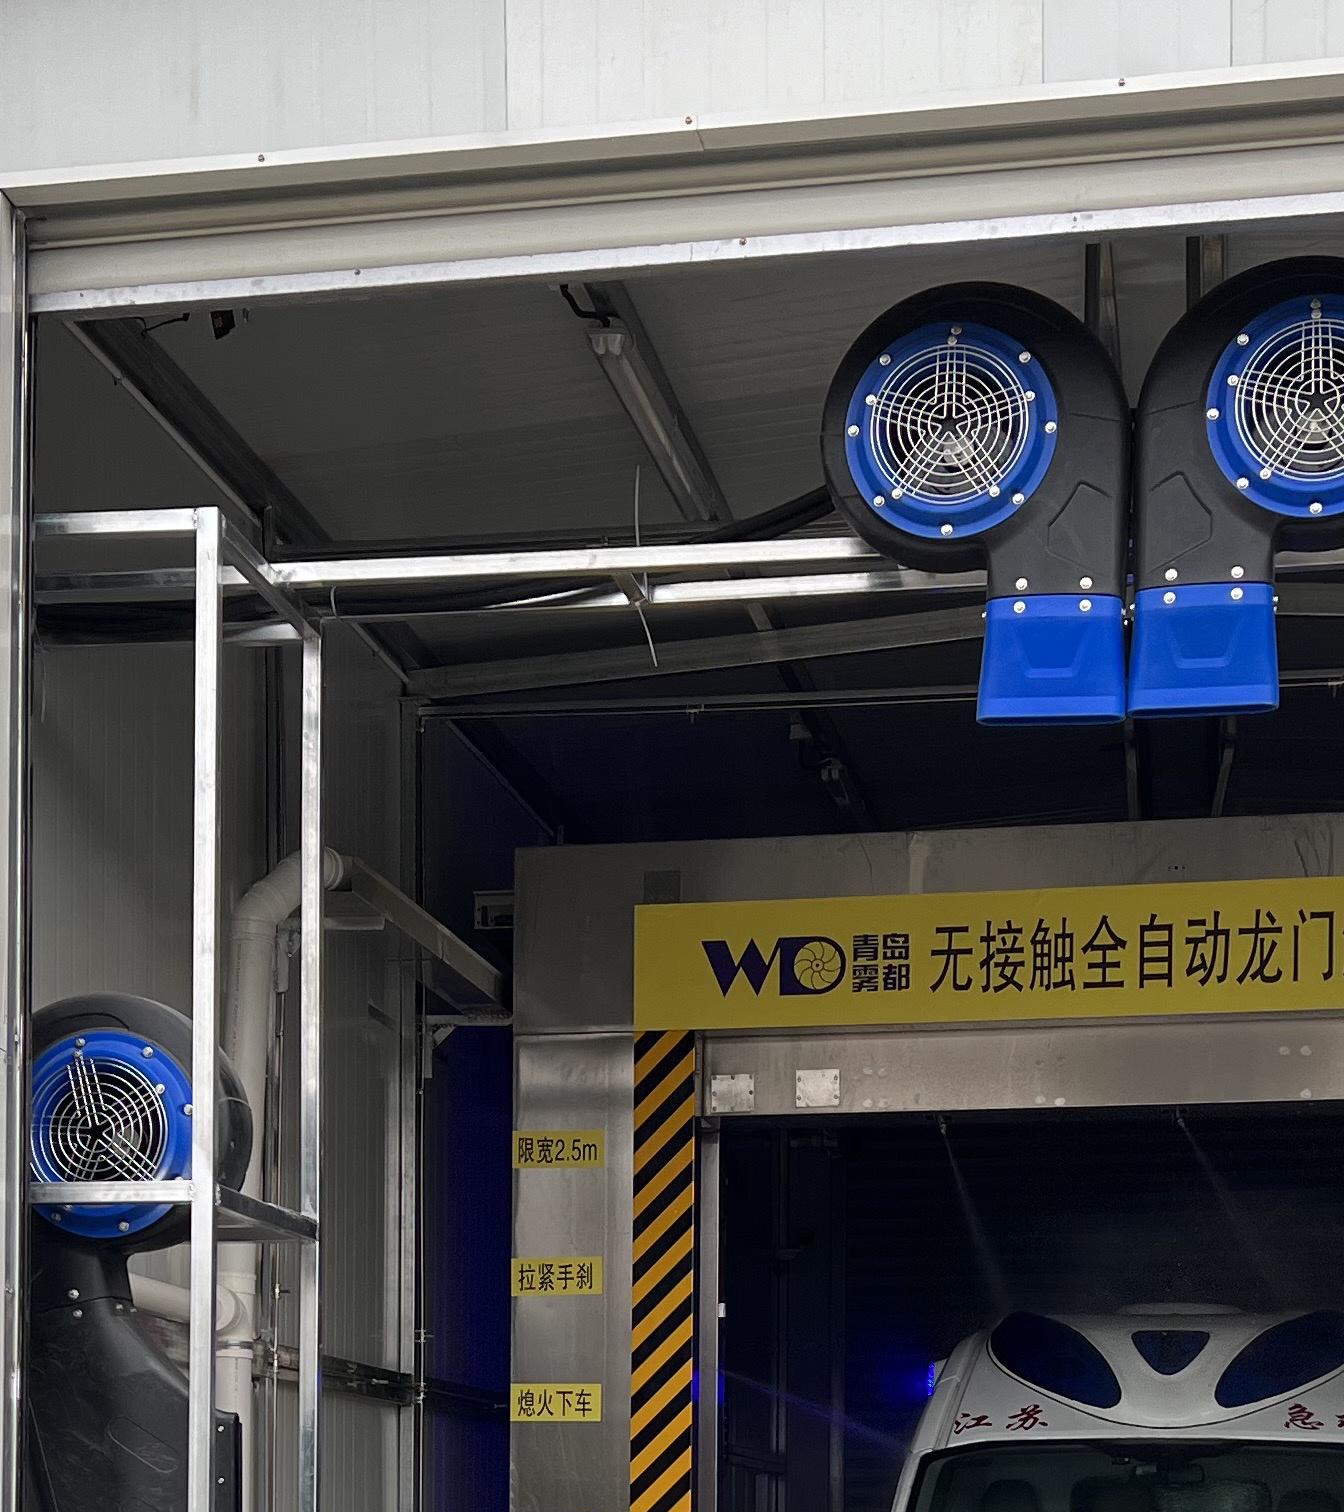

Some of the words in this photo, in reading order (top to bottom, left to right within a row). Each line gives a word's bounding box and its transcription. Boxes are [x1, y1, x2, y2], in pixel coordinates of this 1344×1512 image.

[853, 933, 910, 961] 青岛
[852, 964, 910, 992] 雾都
[518, 1137, 598, 1163] 限宽2.5m
[518, 1262, 593, 1291] 拉紧手刹
[517, 1388, 592, 1417] 熄火下车
[954, 1404, 1048, 1434] 江苏
